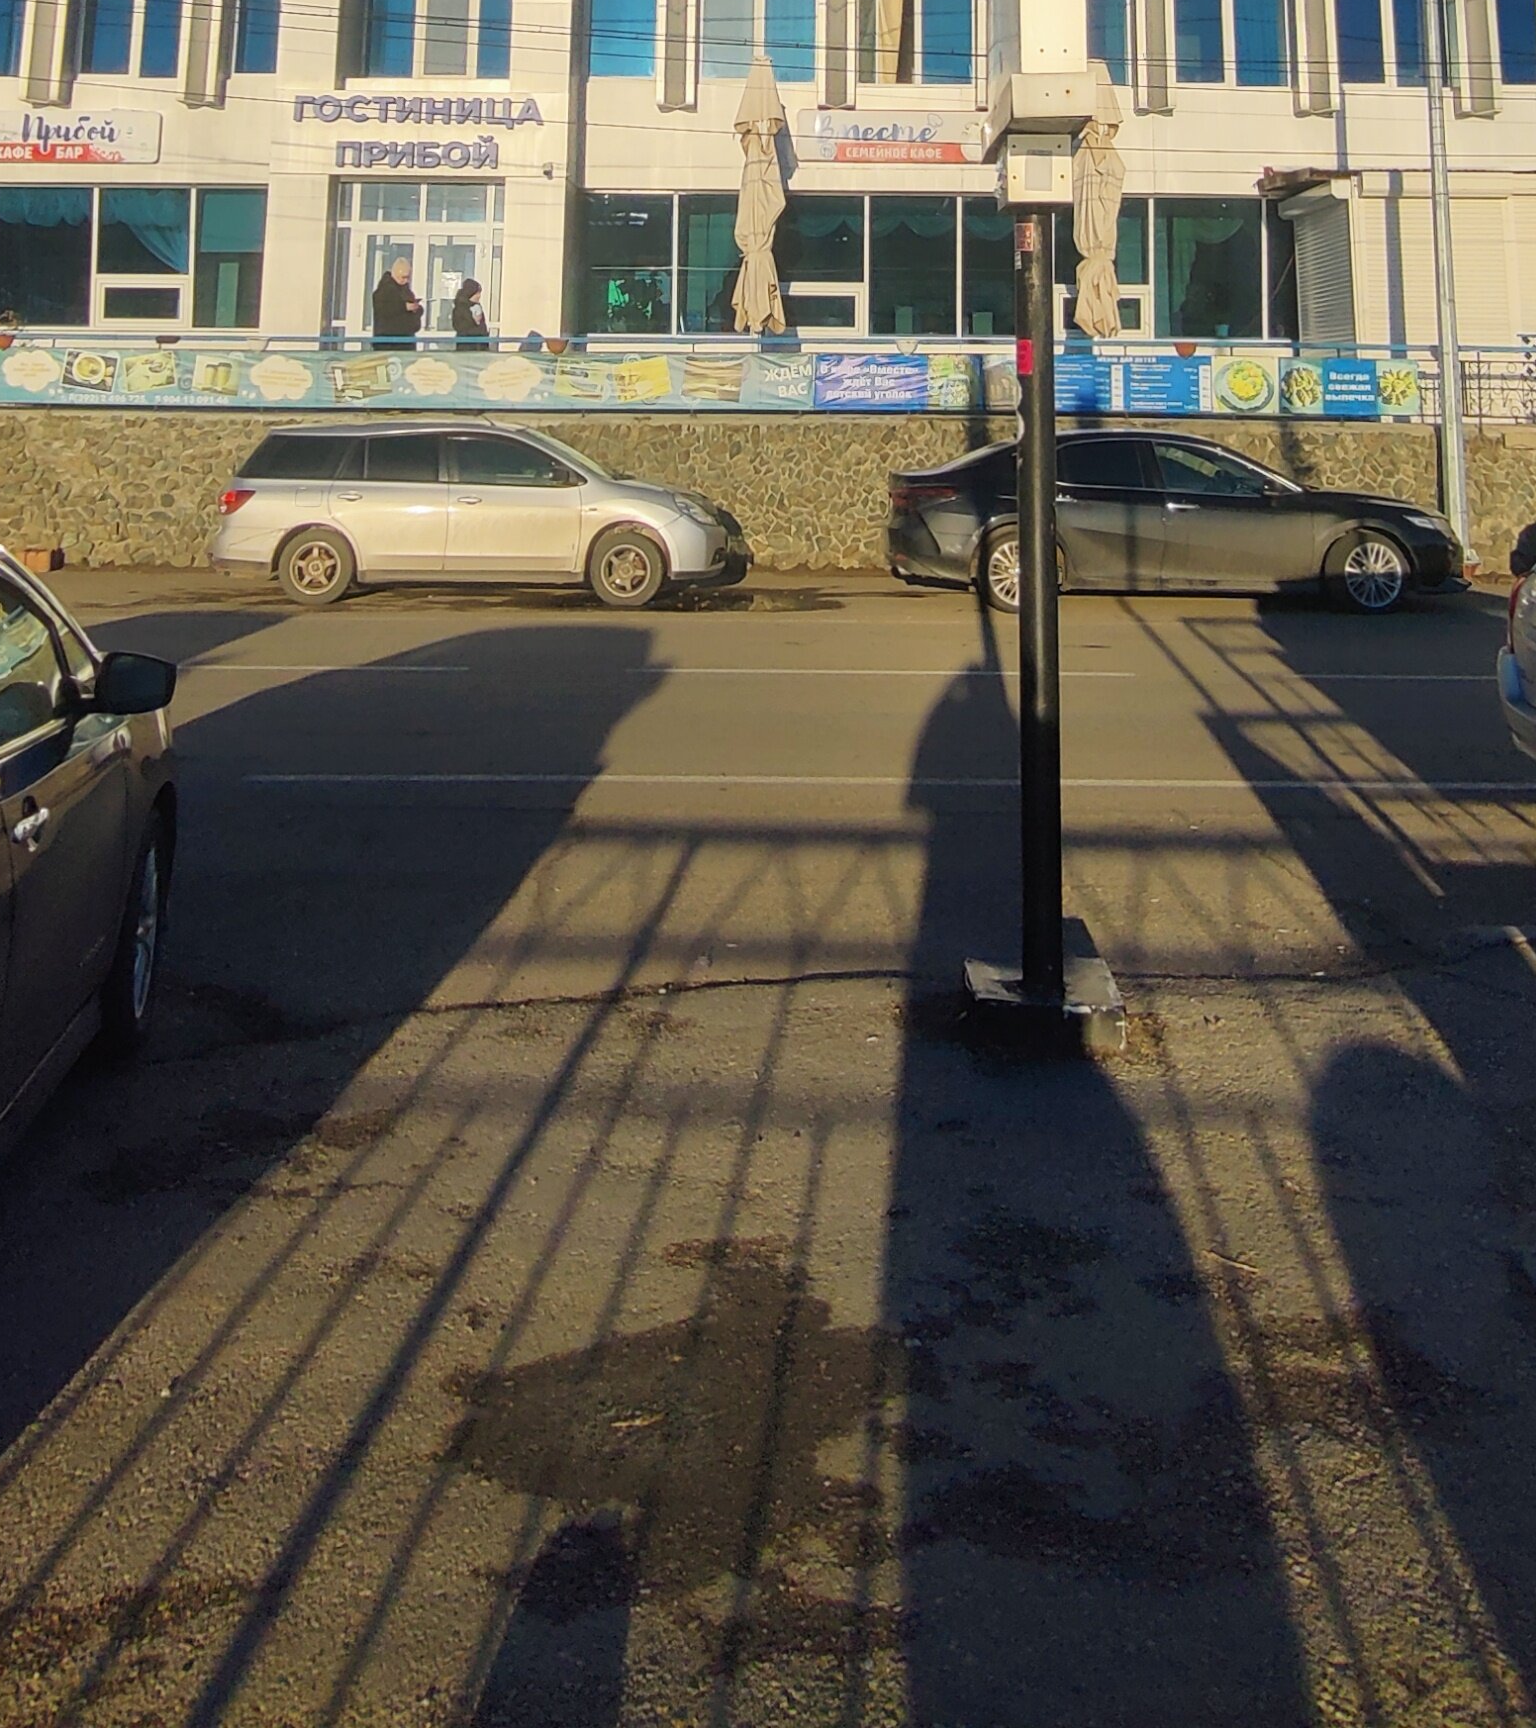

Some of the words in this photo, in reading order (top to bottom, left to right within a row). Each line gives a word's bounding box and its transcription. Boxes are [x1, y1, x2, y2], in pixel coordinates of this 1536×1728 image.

[292, 94, 544, 130] ГОСТИНИЦА
[21, 113, 120, 152] Прибой
[55, 147, 84, 160] БАР
[334, 134, 499, 169] ПРИБОЙ
[845, 145, 908, 160] СЕМЕЙНОЕ
[910, 147, 943, 160] КАФЕ
[1329, 371, 1370, 381] Всегда
[777, 383, 809, 398] ВАС
[1325, 394, 1376, 402] выпечка
